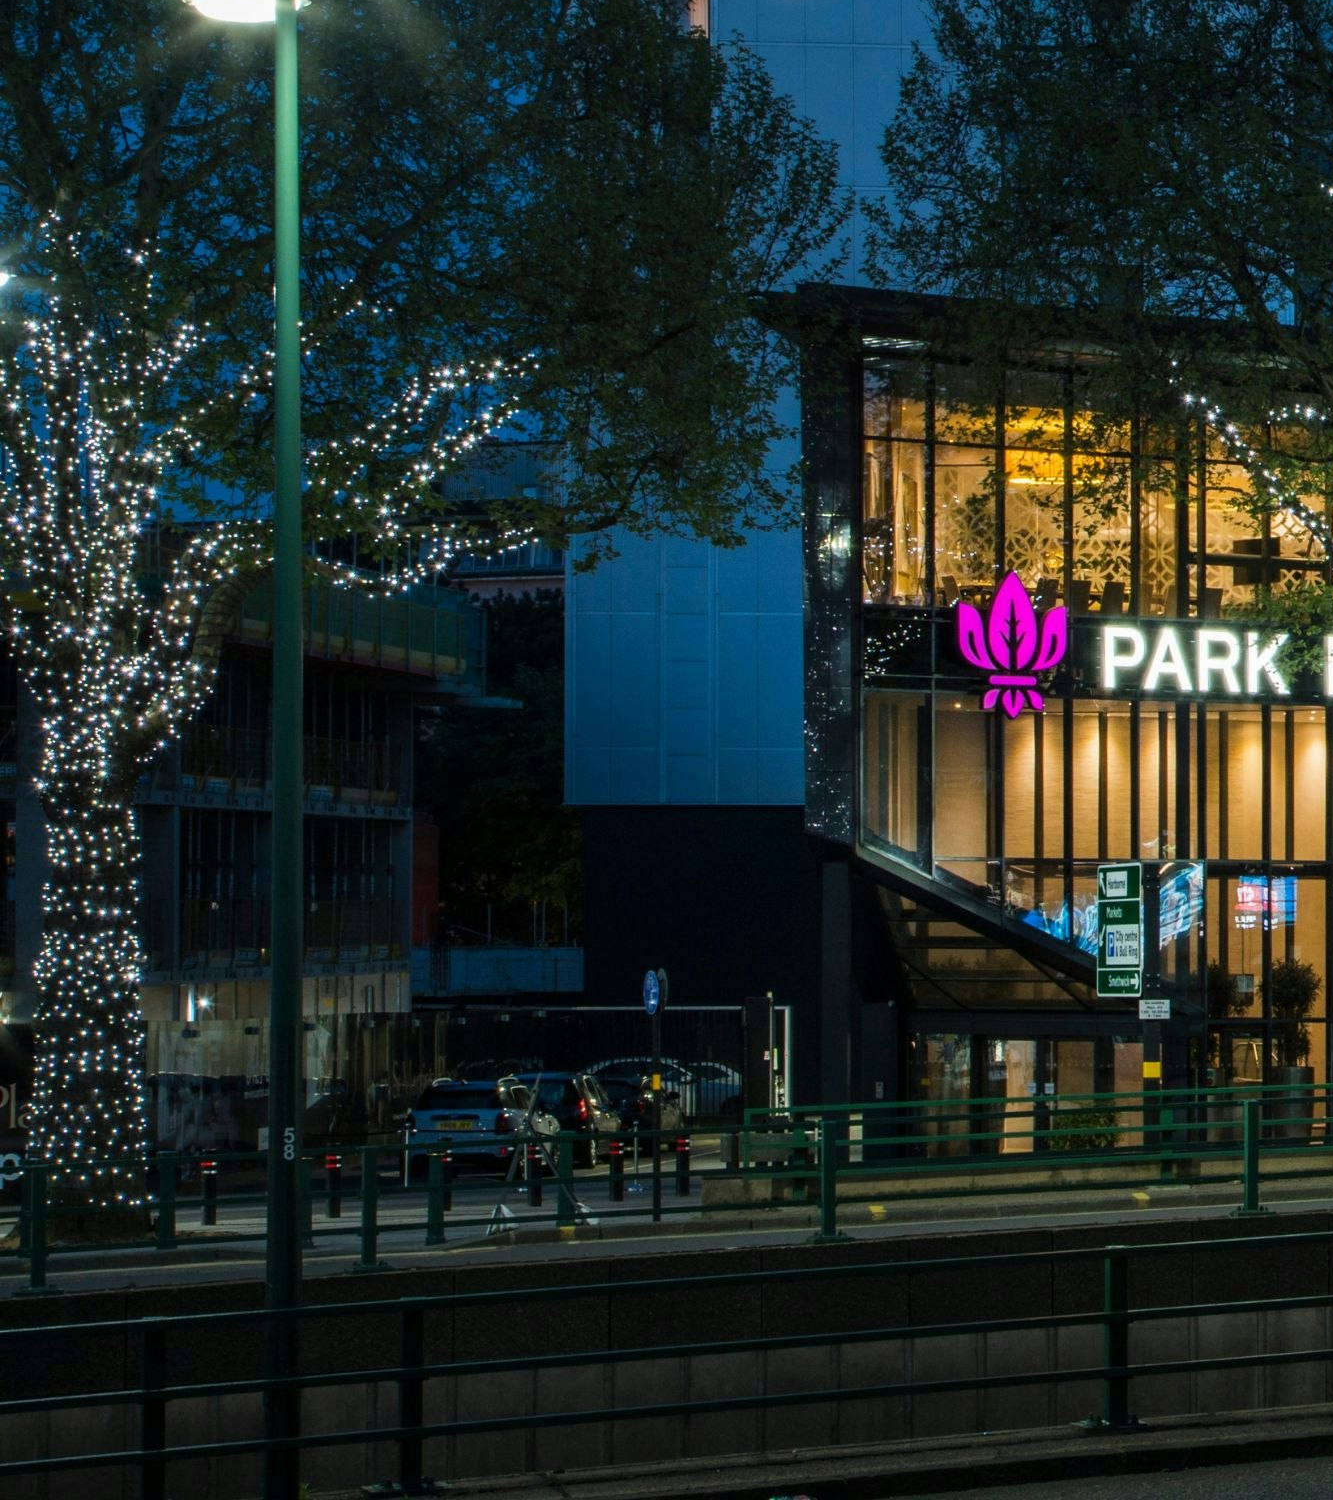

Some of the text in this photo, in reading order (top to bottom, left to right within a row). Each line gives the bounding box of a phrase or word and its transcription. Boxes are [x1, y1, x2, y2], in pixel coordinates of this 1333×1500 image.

[1101, 626, 1291, 696] PARK
[1125, 931, 1138, 942] centre
[1128, 946, 1138, 959] Ring
[1108, 975, 1130, 988] Smethwick
